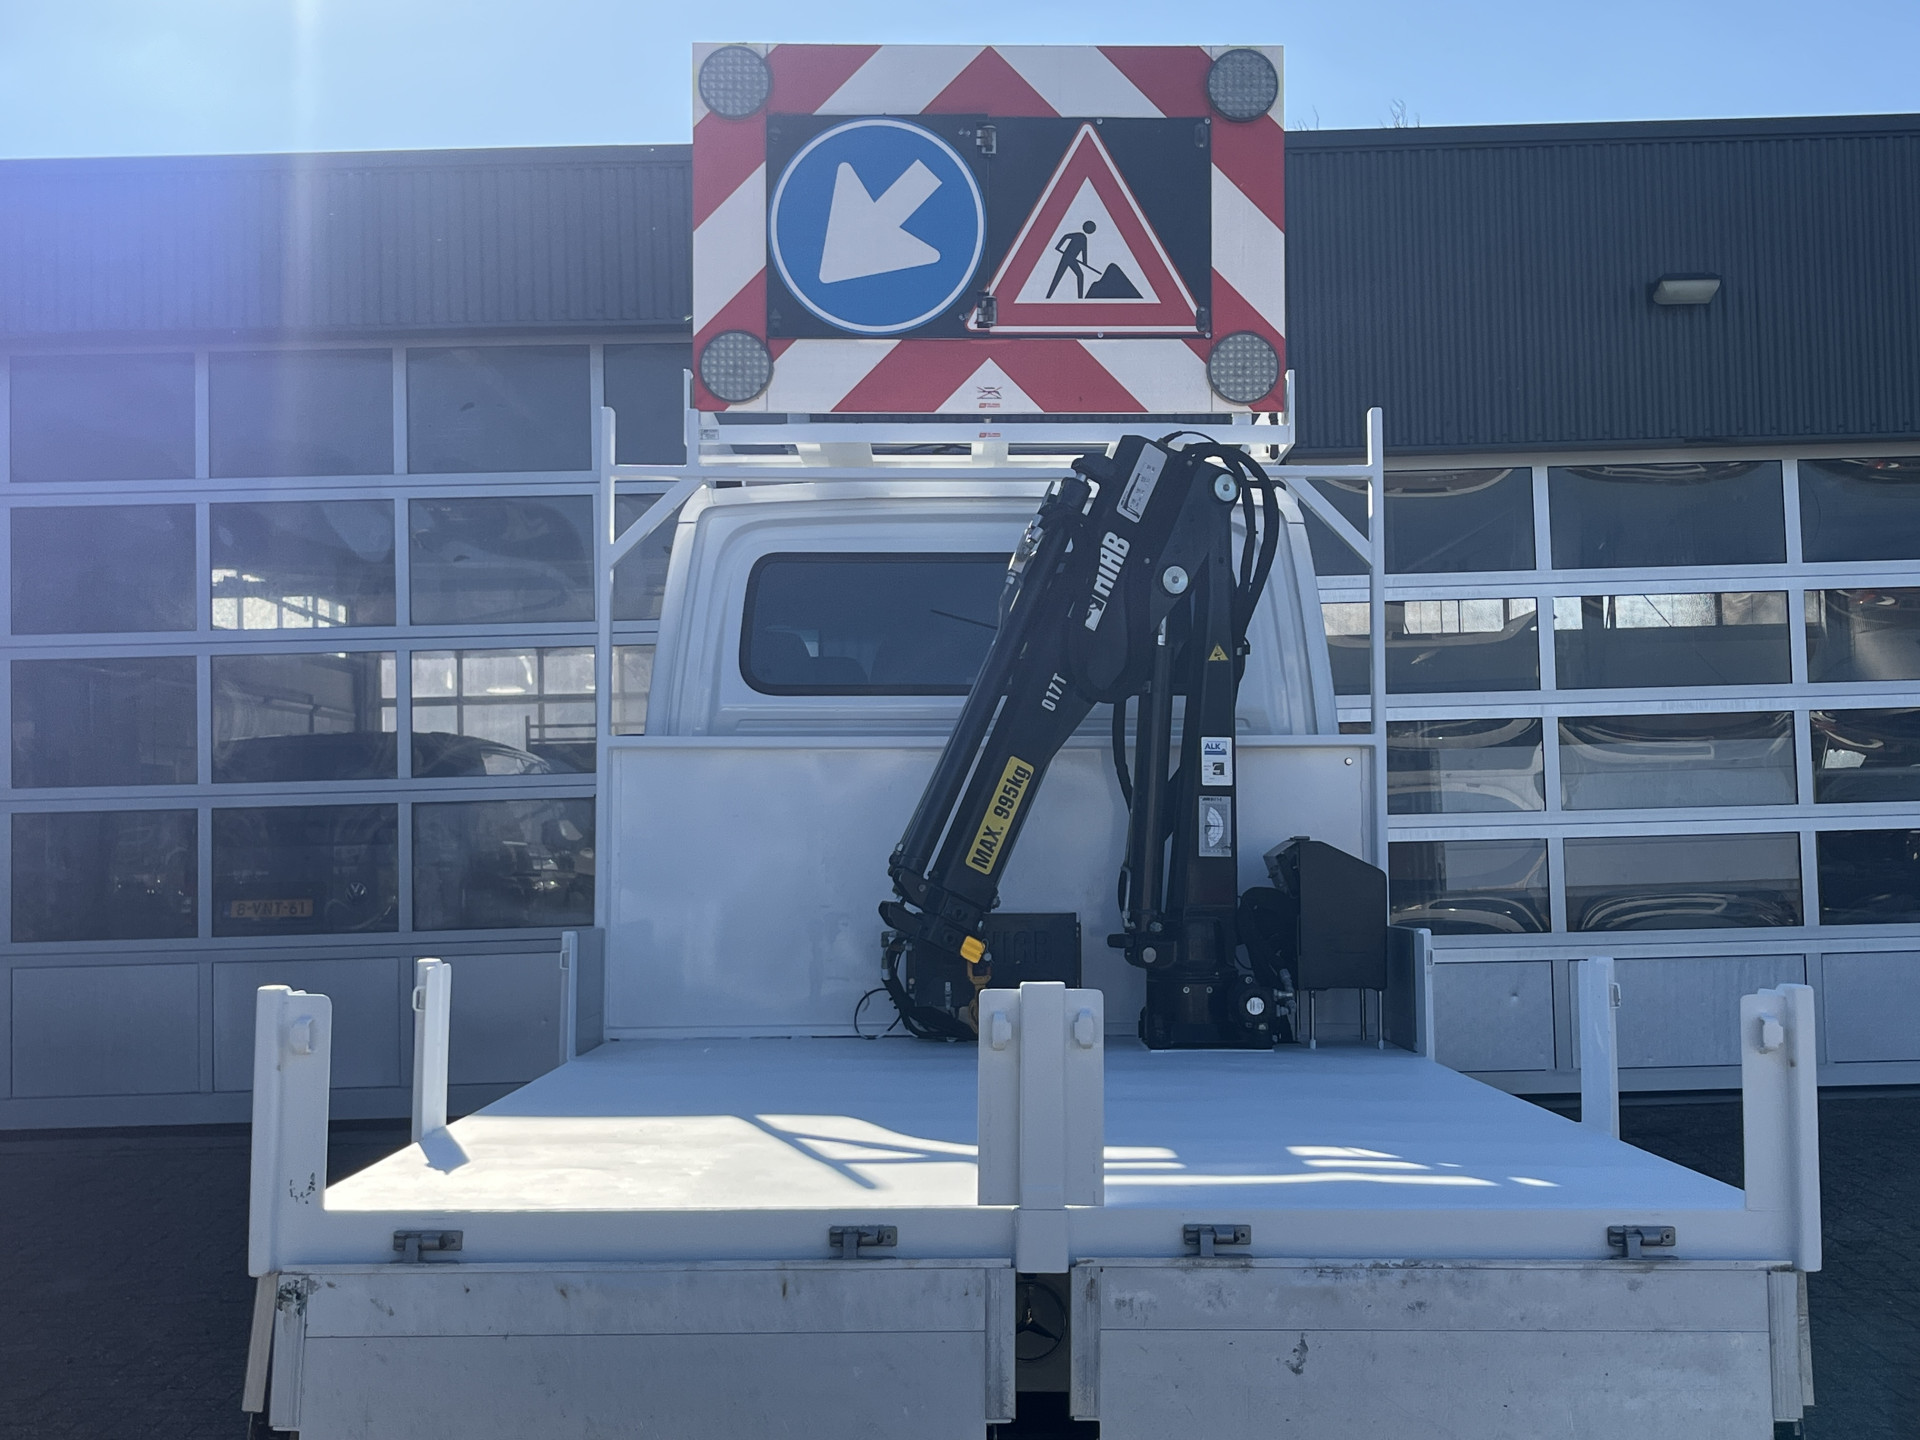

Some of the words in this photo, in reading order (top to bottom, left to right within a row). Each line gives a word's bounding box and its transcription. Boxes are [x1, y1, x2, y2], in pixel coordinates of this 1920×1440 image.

[1093, 532, 1131, 597] HIAB
[1042, 673, 1067, 711] 017T
[1204, 742, 1221, 750] ALK
[971, 825, 1004, 870] MAX.
[994, 765, 1032, 820] 995kg
